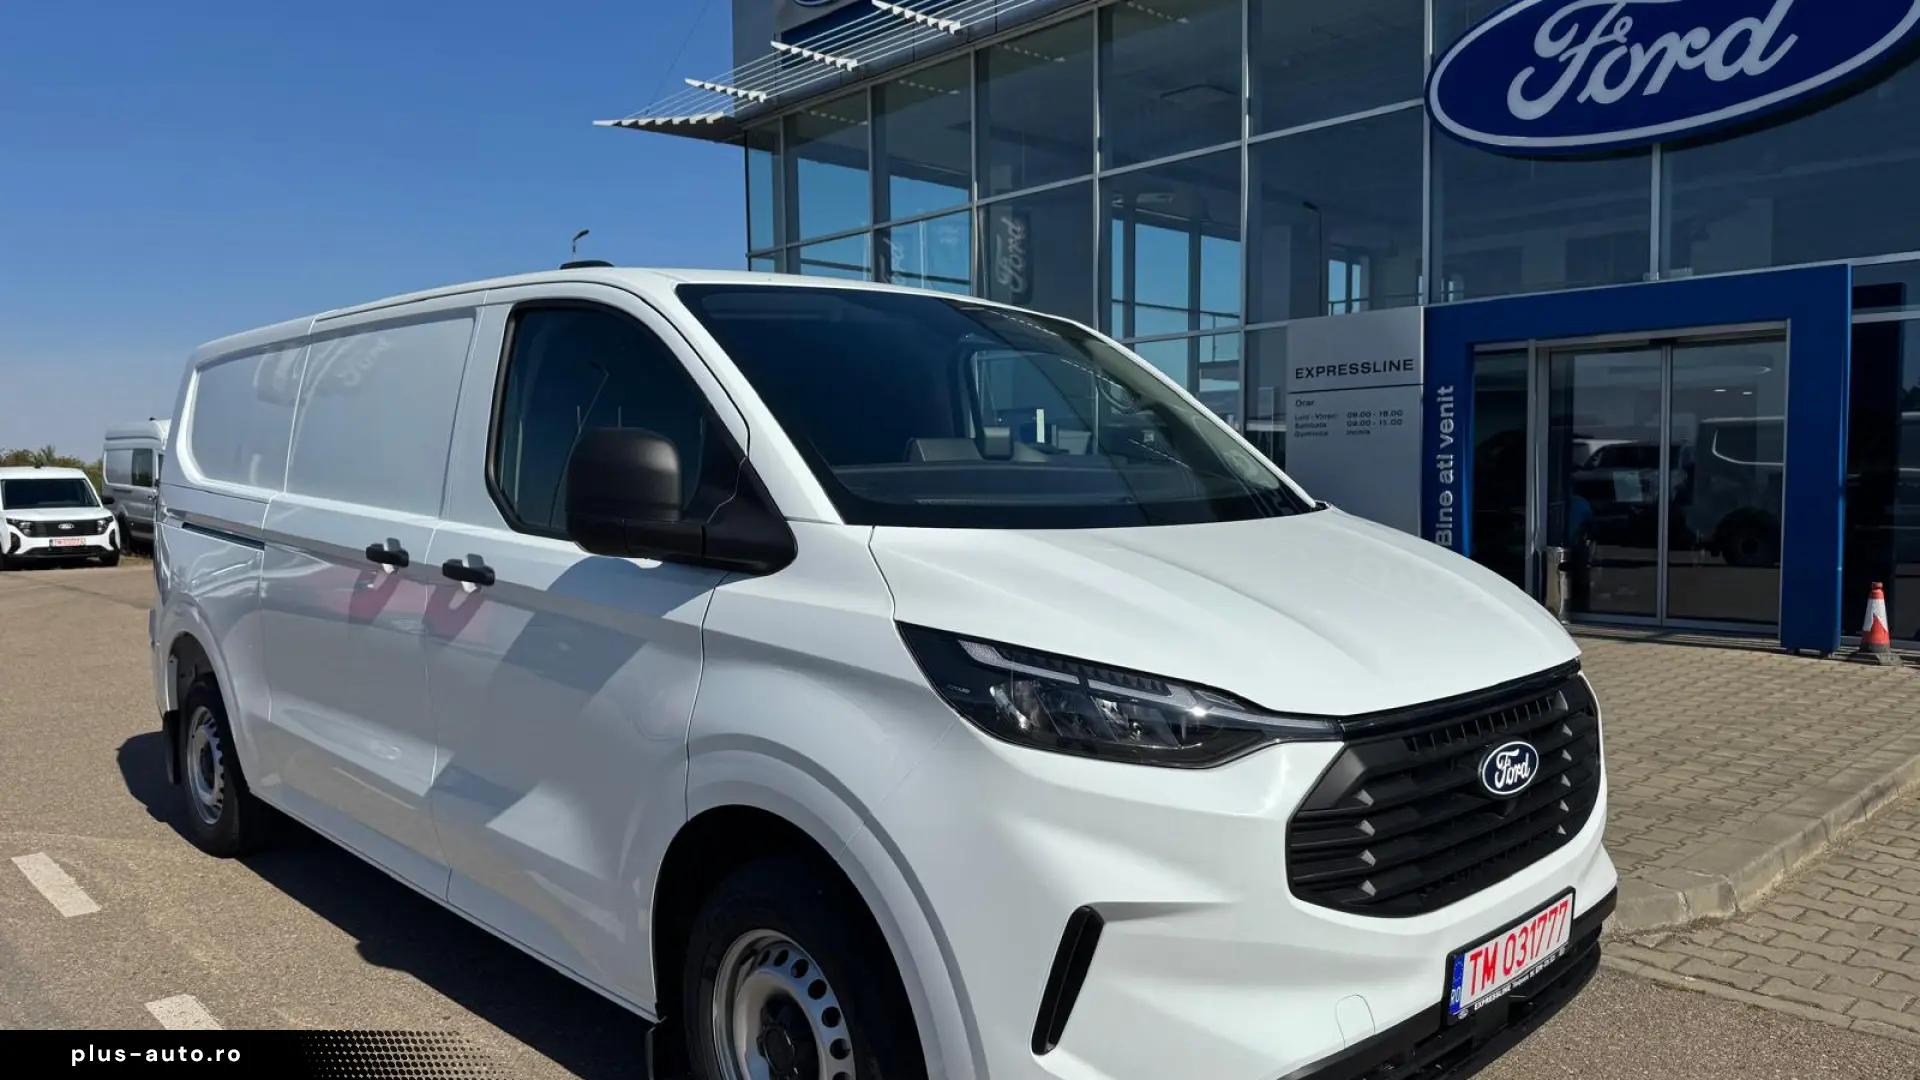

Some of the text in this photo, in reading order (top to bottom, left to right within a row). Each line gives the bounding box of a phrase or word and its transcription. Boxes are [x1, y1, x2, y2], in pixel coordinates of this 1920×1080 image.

[1507, 0, 1798, 120] Ford
[1294, 358, 1414, 380] EXPRESSLINE
[1295, 399, 1315, 408] Orar
[1435, 385, 1454, 448] venit
[1435, 490, 1453, 546] Bine
[1494, 748, 1530, 788] Ford
[1470, 941, 1498, 996] TM
[1502, 899, 1569, 977] 031777
[1450, 986, 1461, 1006] RO
